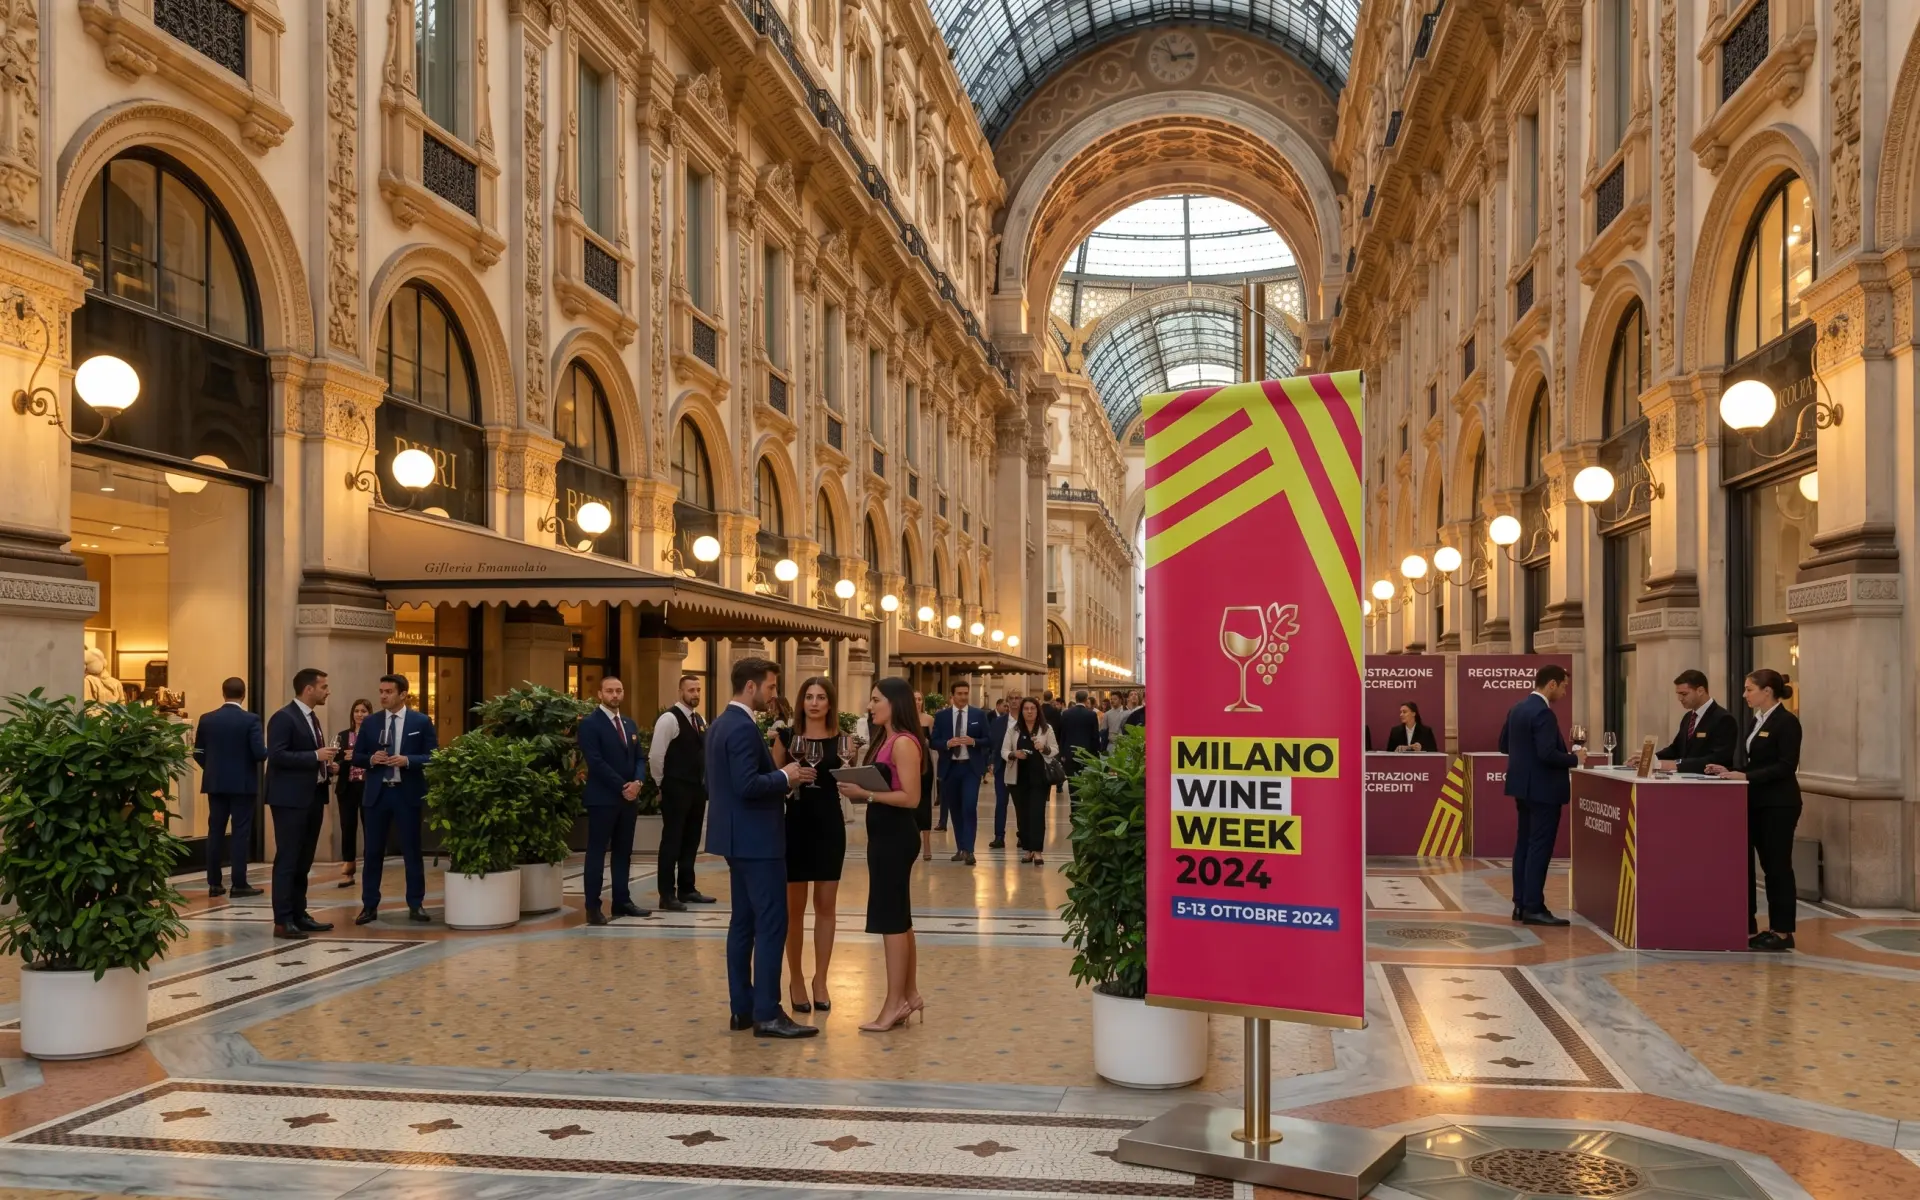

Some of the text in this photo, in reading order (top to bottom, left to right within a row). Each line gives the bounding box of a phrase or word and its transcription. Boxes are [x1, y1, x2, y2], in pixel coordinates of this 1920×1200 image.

[1364, 668, 1433, 677] ISTRAZIONE
[1468, 668, 1537, 677] REGISTRAZI
[1364, 680, 1417, 689] CCREDITI
[1483, 680, 1536, 689] ACCREDI
[1177, 741, 1334, 773] MILANO
[1364, 772, 1429, 781] STRAZIONE
[1364, 783, 1413, 792] CREDITI
[1176, 779, 1282, 811] WINE
[1176, 815, 1296, 850] WEEK
[1176, 855, 1272, 889] 2024
[1177, 902, 1333, 926] 5-13 OTTOBRE 2024
